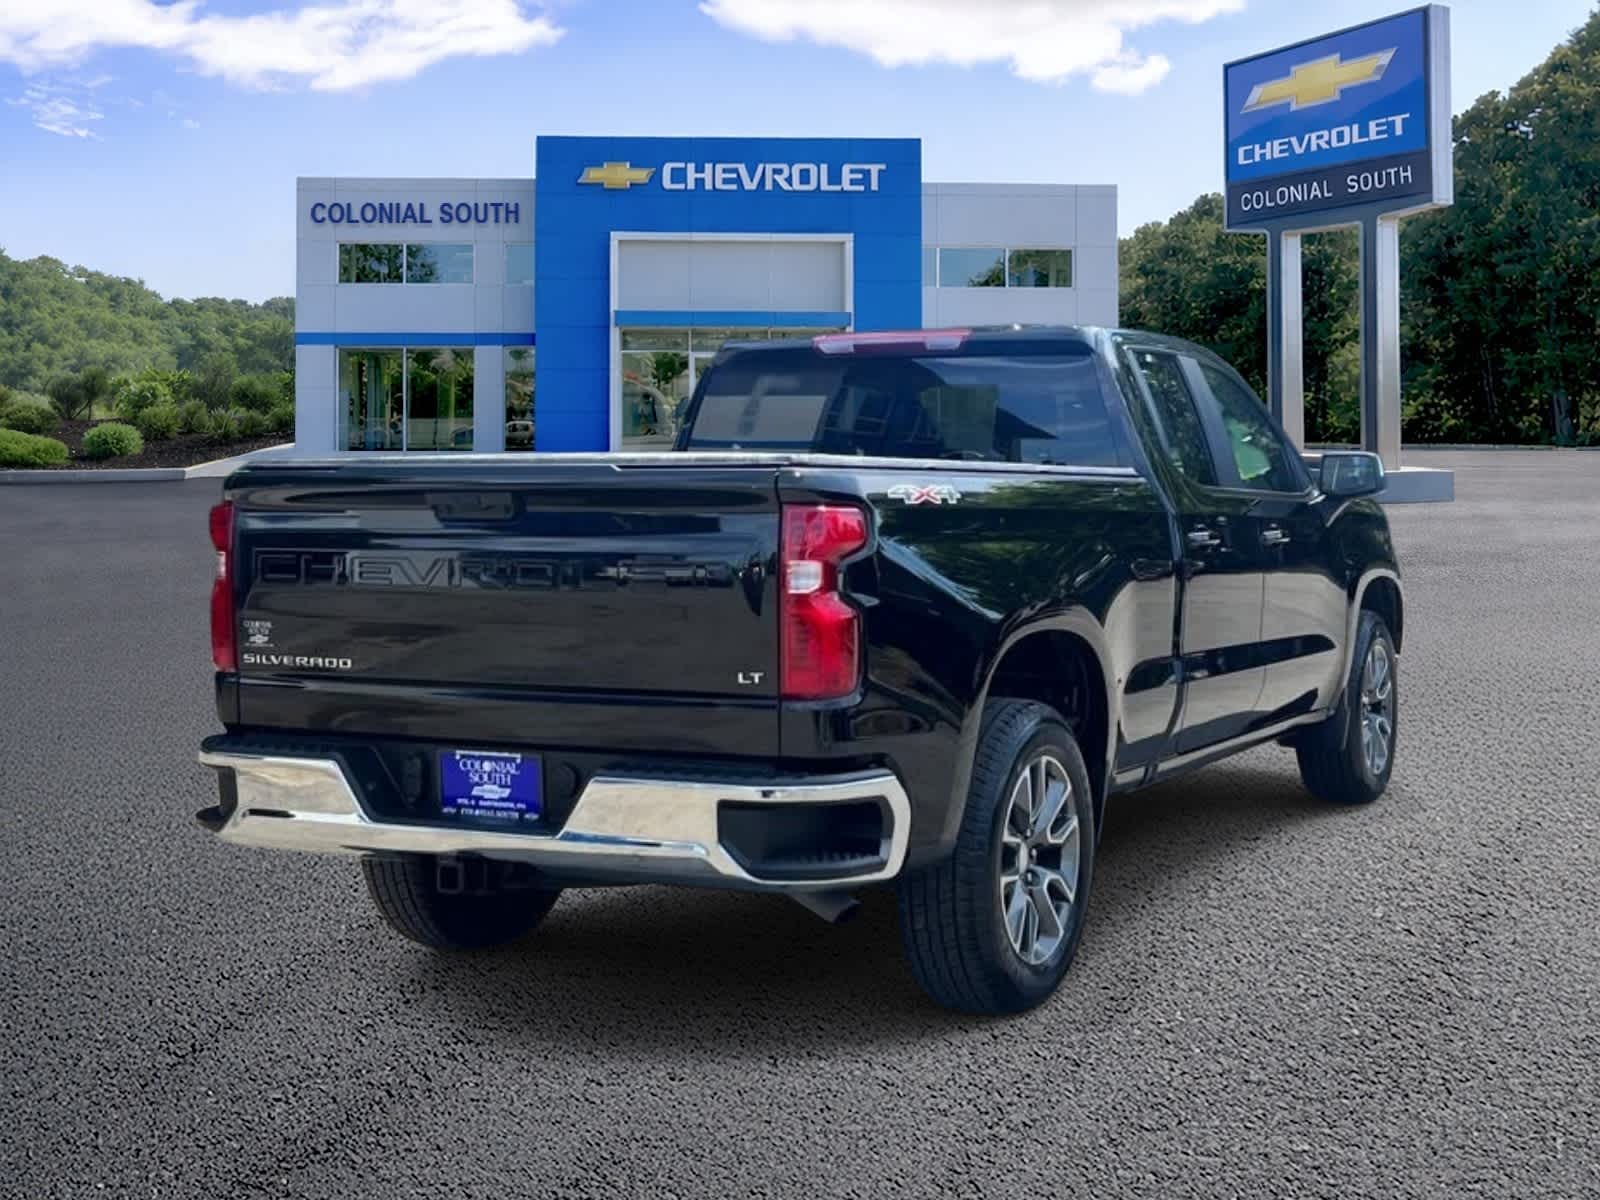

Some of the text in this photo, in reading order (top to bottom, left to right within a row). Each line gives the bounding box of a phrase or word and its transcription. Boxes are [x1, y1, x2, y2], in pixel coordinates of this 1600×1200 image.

[1238, 113, 1410, 165] CHEVROLET
[661, 161, 887, 193] CHEVROLET
[1240, 165, 1412, 212] COLONIAL SOUTH
[310, 201, 521, 226] COLONIAL SOUTH
[255, 552, 735, 588] CHEVRO
[242, 652, 353, 669] SILVERADO
[737, 671, 765, 685] LT
[469, 771, 511, 785] SOUTH
